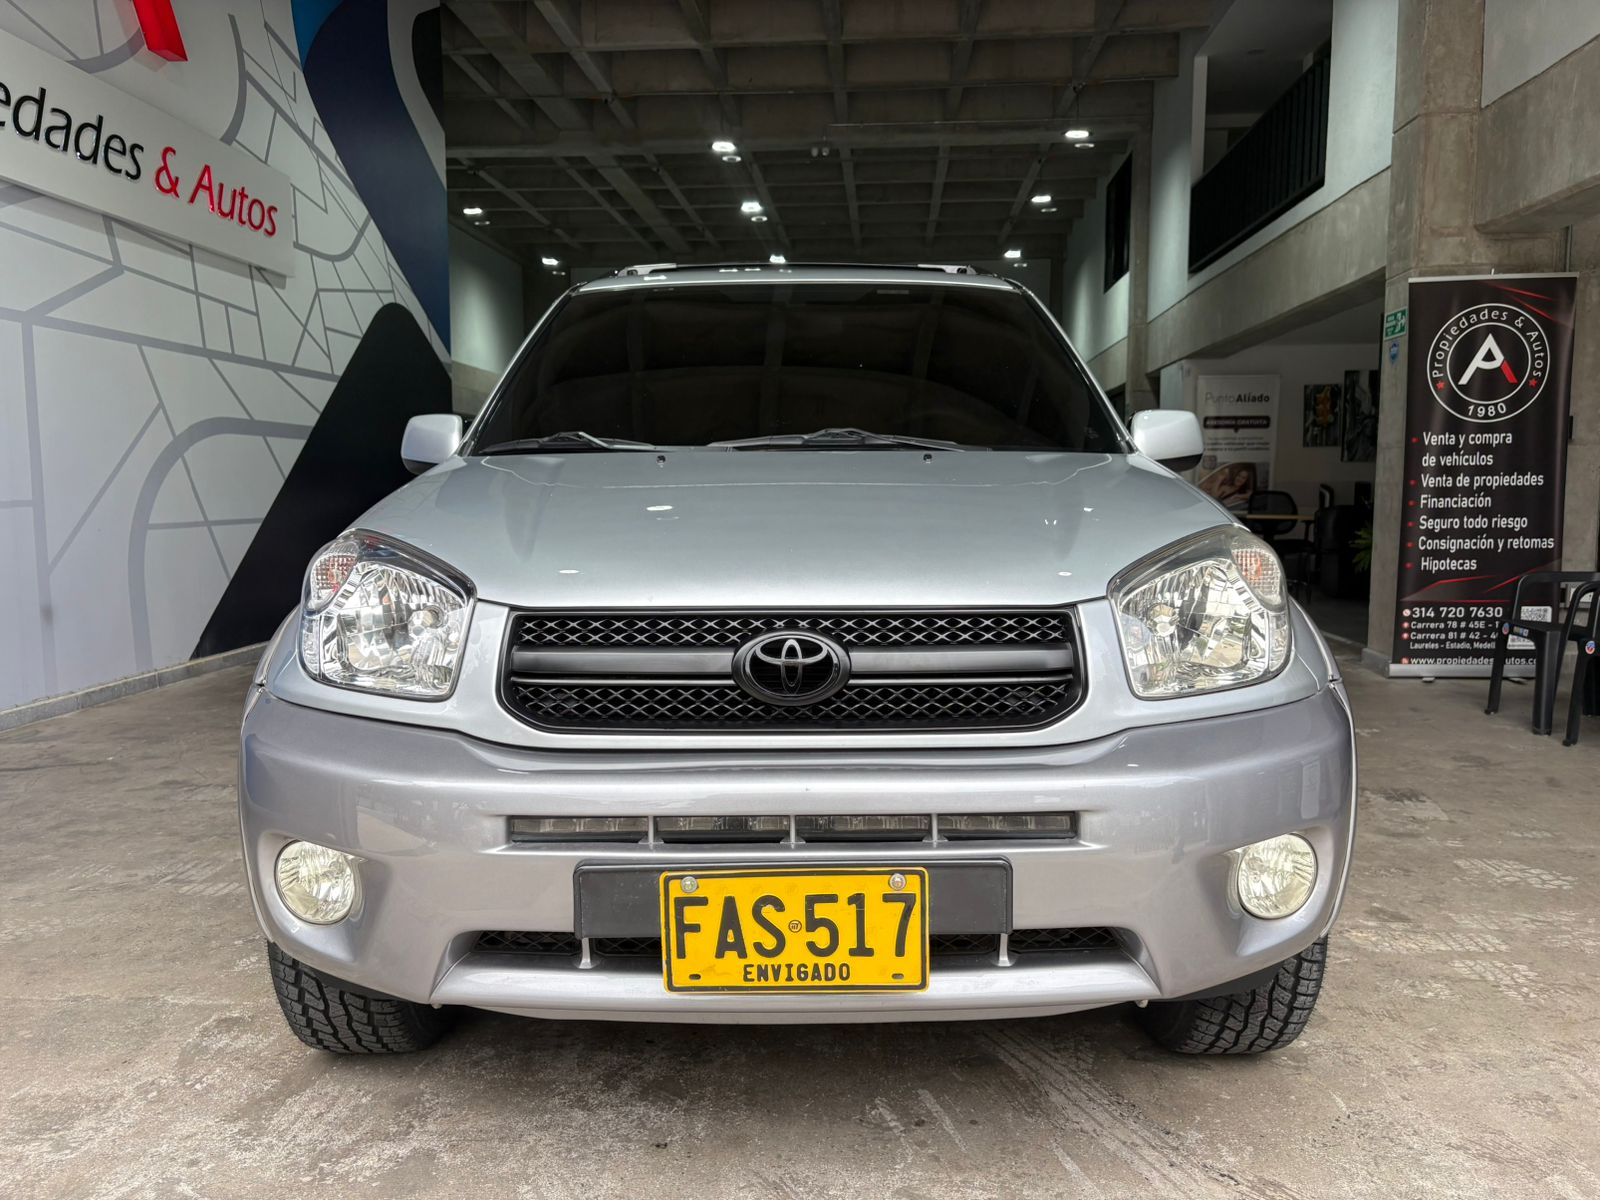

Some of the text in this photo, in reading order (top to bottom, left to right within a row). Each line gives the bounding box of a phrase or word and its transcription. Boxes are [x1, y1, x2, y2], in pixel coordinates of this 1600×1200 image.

[155, 146, 179, 198] &
[188, 164, 278, 236] Autos
[1432, 308, 1508, 378] Propiedades
[1514, 316, 1525, 329] &
[1526, 331, 1544, 377] Autos
[1468, 402, 1506, 417] 1980
[1423, 431, 1512, 448] Venta y compra
[1421, 450, 1494, 466] de vehículos
[1421, 472, 1544, 489] Venta de propiedades
[1420, 492, 1492, 508] Financiación
[1419, 514, 1528, 532] Seguro todo riesgo
[1418, 533, 1555, 553] Consignación y retomas
[1421, 557, 1477, 573] Hipotecas
[1412, 607, 1503, 618] 314 720 7630
[1410, 641, 1439, 649] Laureles
[1446, 641, 1472, 650] Estadio,
[674, 893, 917, 959] FAS 517
[743, 963, 850, 982] ENVIGADO
